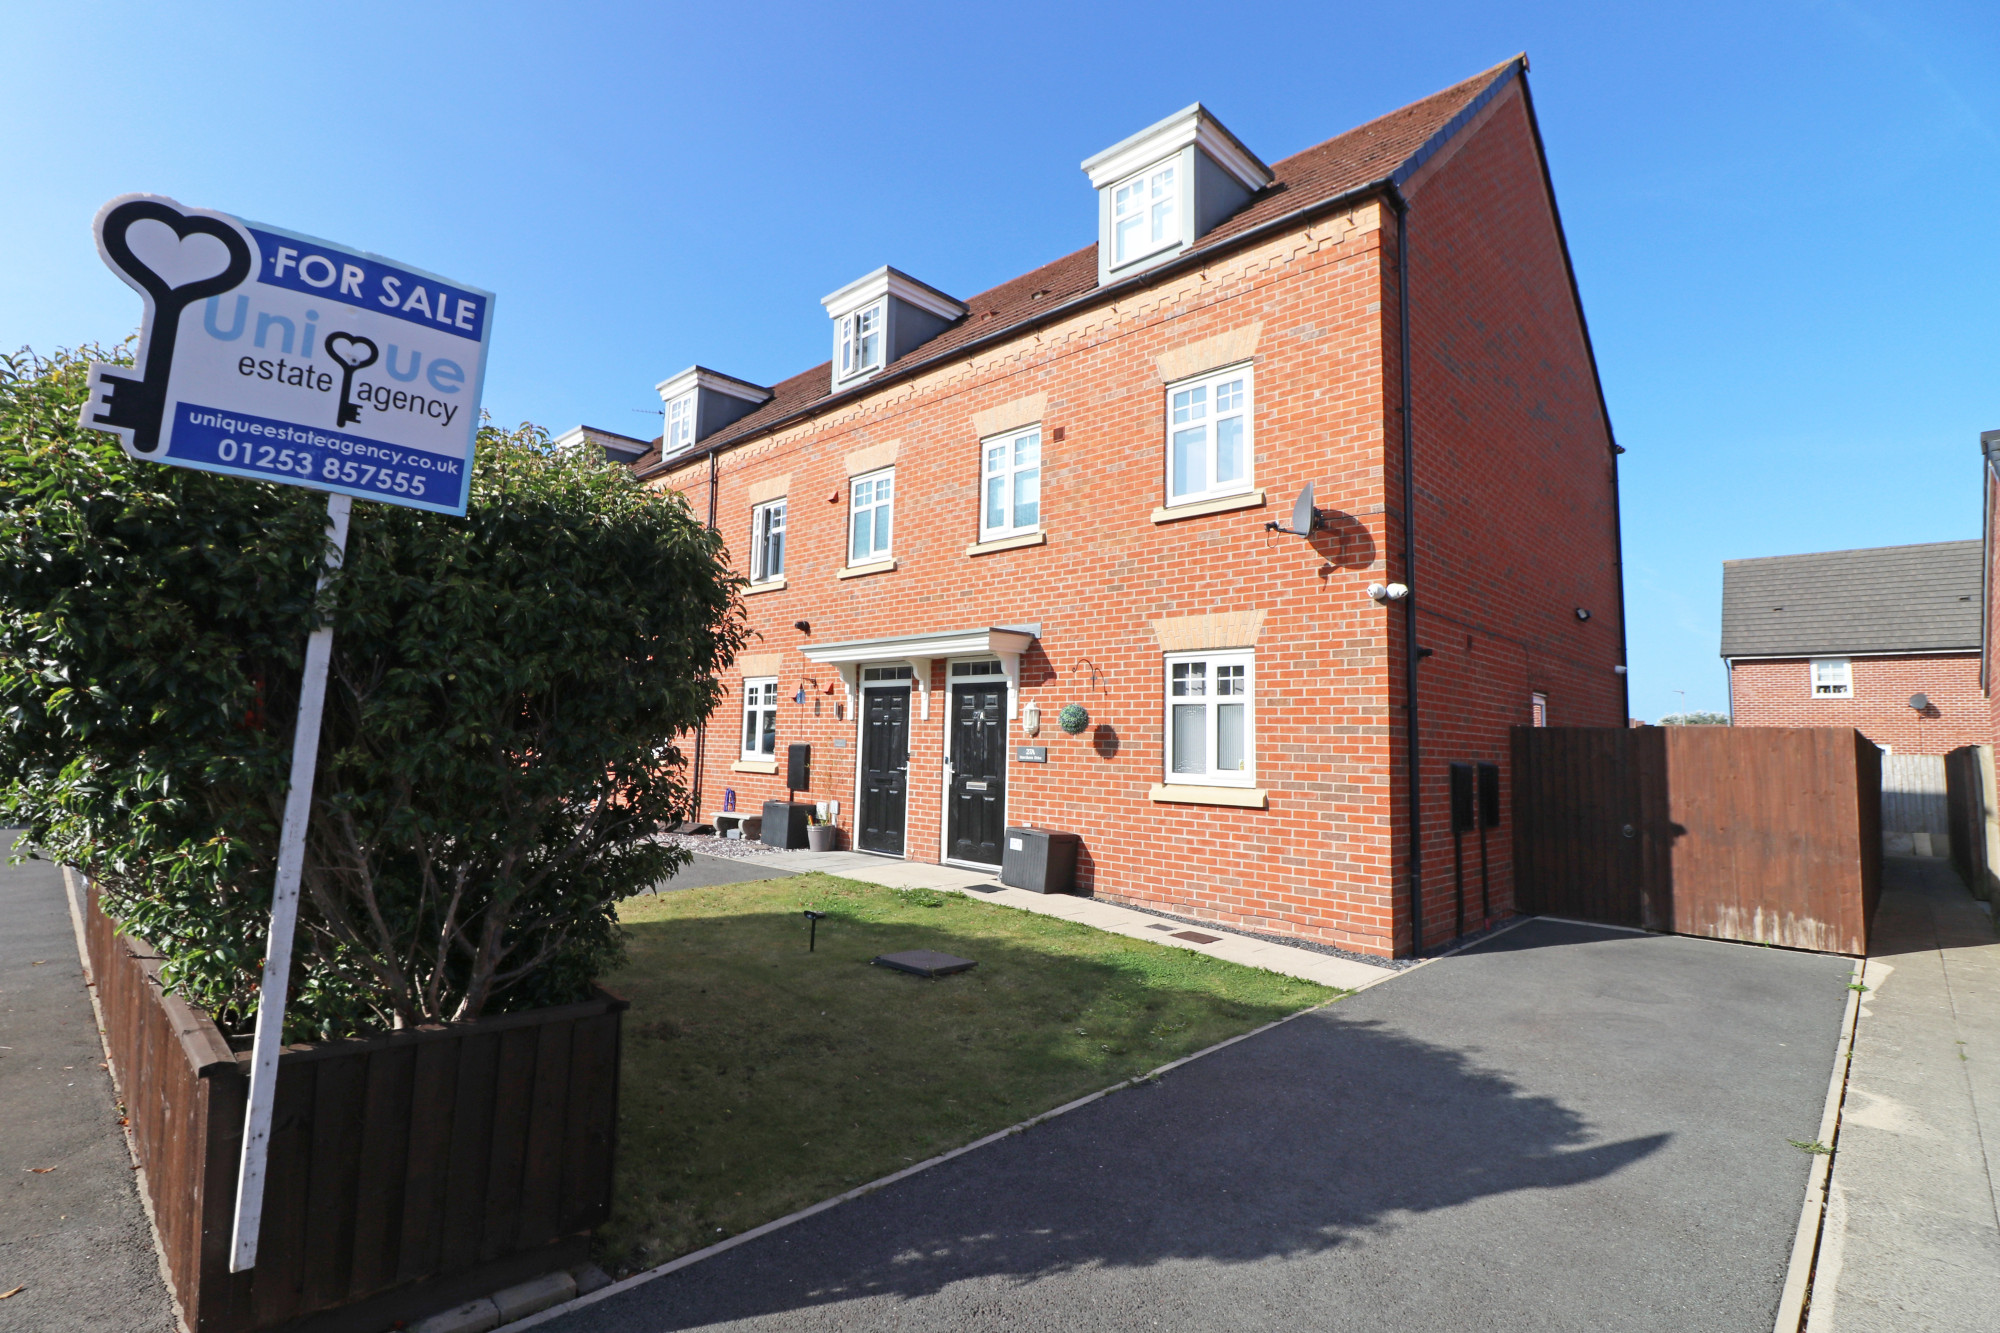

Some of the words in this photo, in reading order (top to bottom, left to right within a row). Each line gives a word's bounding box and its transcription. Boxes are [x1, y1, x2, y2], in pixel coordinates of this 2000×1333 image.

[274, 246, 364, 299] FOR
[378, 275, 476, 331] SALE
[238, 355, 333, 393] estate
[357, 382, 458, 427] agency
[190, 411, 459, 476] uniqueestateagency.co.uk
[217, 439, 313, 475] 01253
[322, 457, 427, 496] 857555
